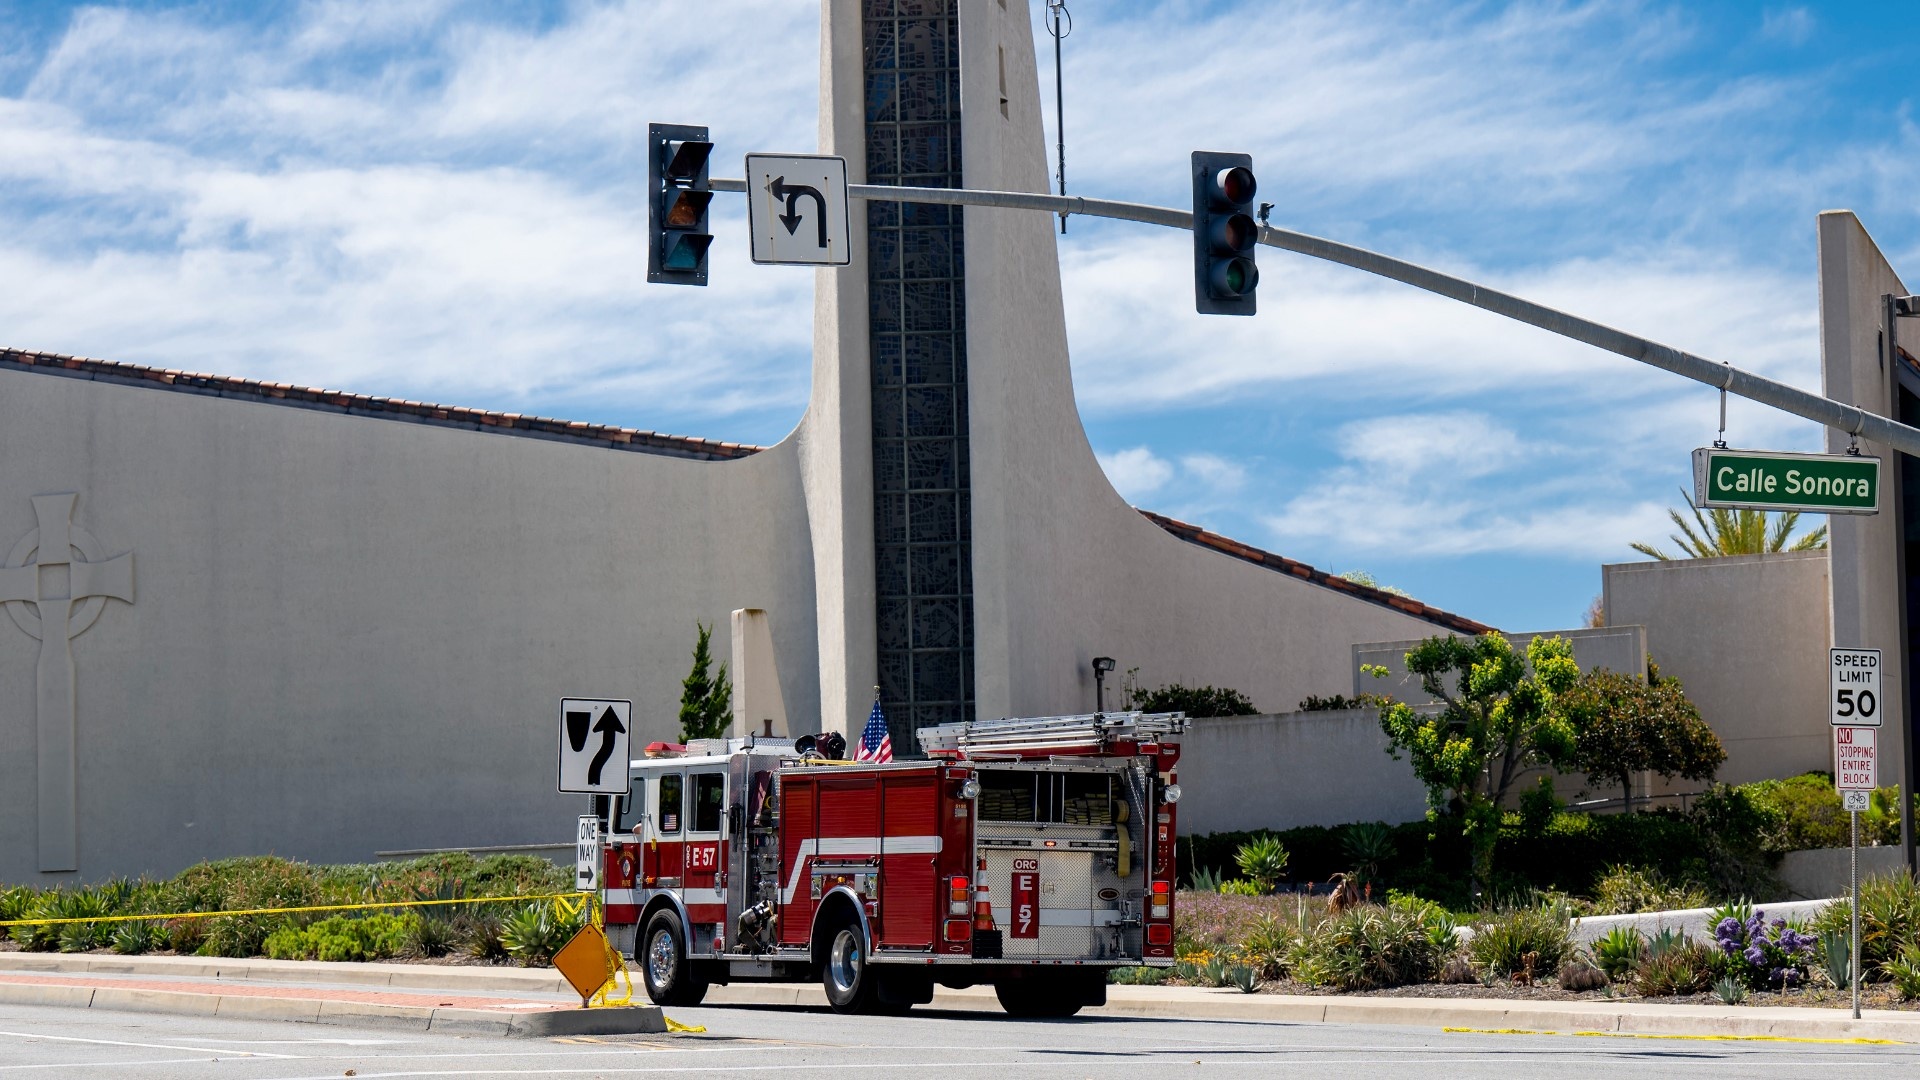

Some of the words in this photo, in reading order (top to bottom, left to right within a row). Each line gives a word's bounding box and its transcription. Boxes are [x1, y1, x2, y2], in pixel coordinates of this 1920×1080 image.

[1717, 466, 1777, 493] Calle
[1784, 469, 1869, 497] Sonora
[1835, 655, 1877, 667] SPEED
[1839, 671, 1872, 683] LIMIT
[1837, 689, 1876, 717] 50
[1838, 729, 1852, 743] NO
[1840, 746, 1873, 758] STOPPING
[1843, 761, 1871, 770] ENTIRE
[1844, 774, 1870, 783] BLOCK
[581, 822, 596, 840] ONE
[579, 844, 594, 862] WAY
[702, 848, 716, 866] 57
[1015, 860, 1036, 869] ORC
